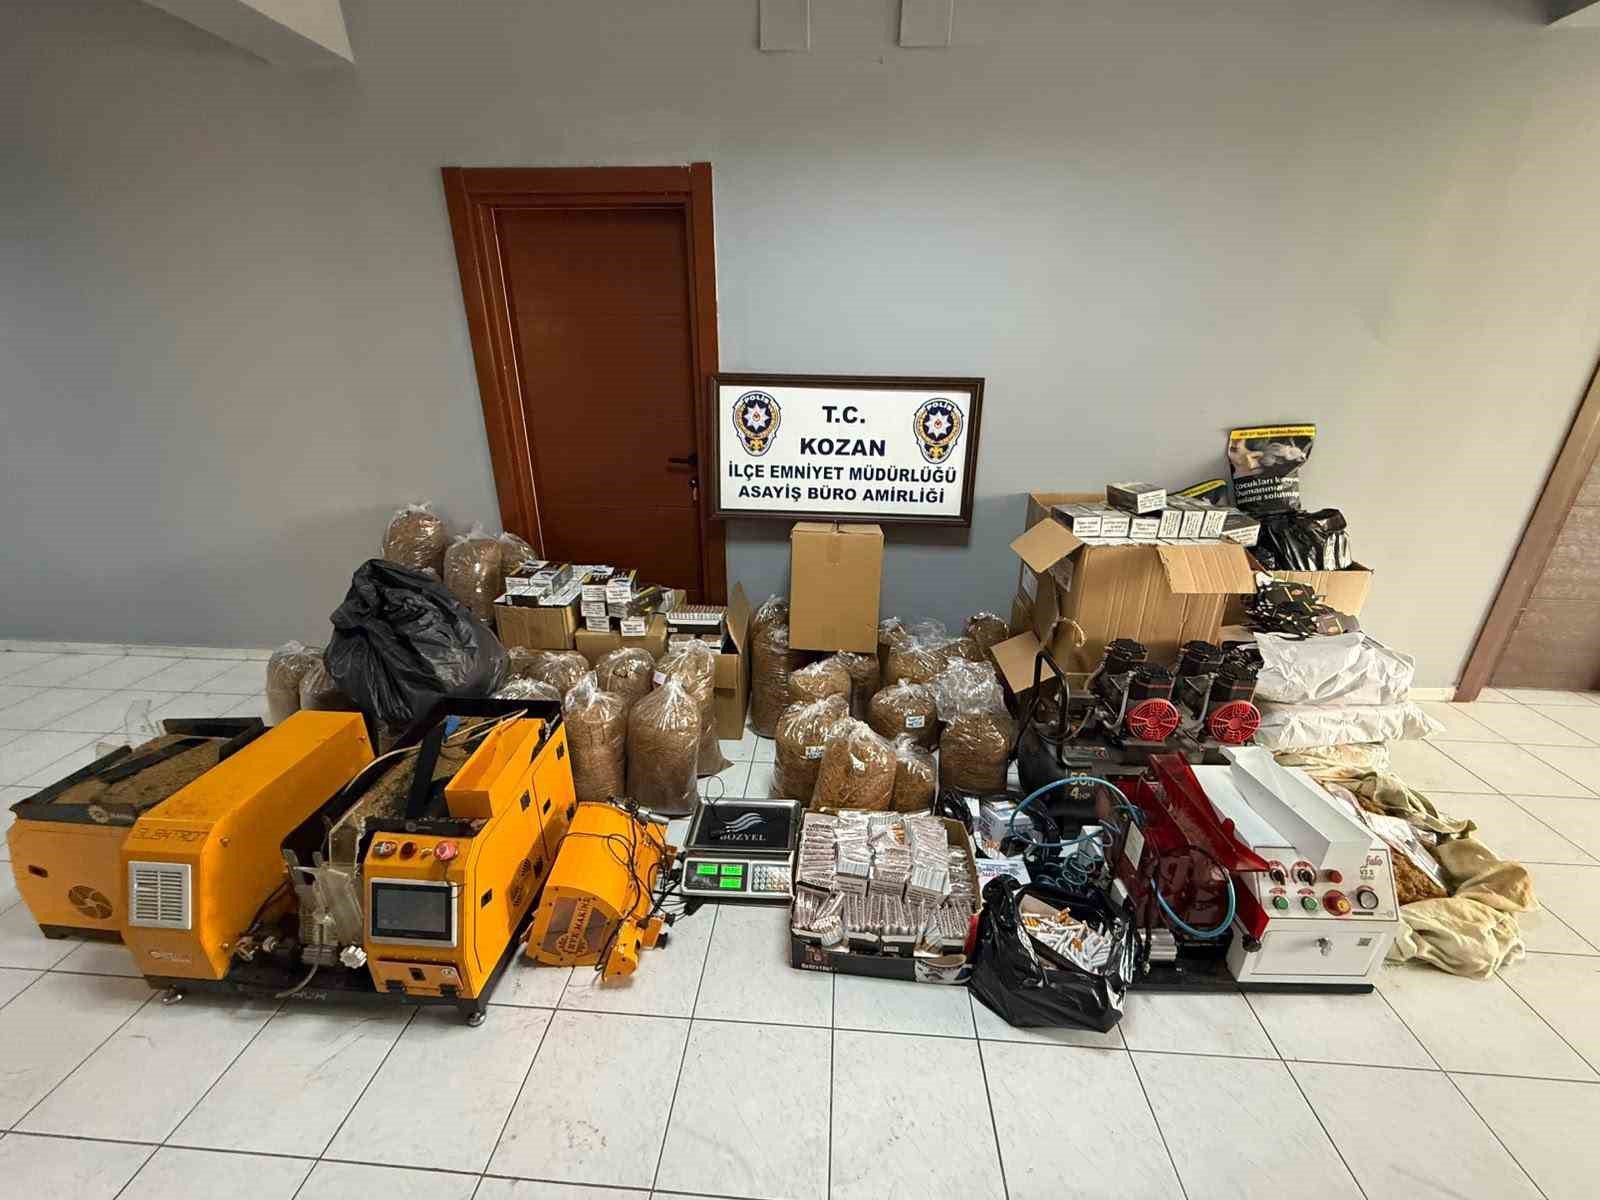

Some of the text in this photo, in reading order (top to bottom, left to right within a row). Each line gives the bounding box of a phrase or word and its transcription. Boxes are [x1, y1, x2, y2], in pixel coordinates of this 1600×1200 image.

[822, 406, 865, 423] T.C.
[800, 438, 886, 456] KOZAN
[728, 461, 956, 483] İLÇE EMNİYET MÜDÜRLÜĞÜ
[738, 484, 944, 503] ASAYİŞ BÜRO AMİRLİĞİ
